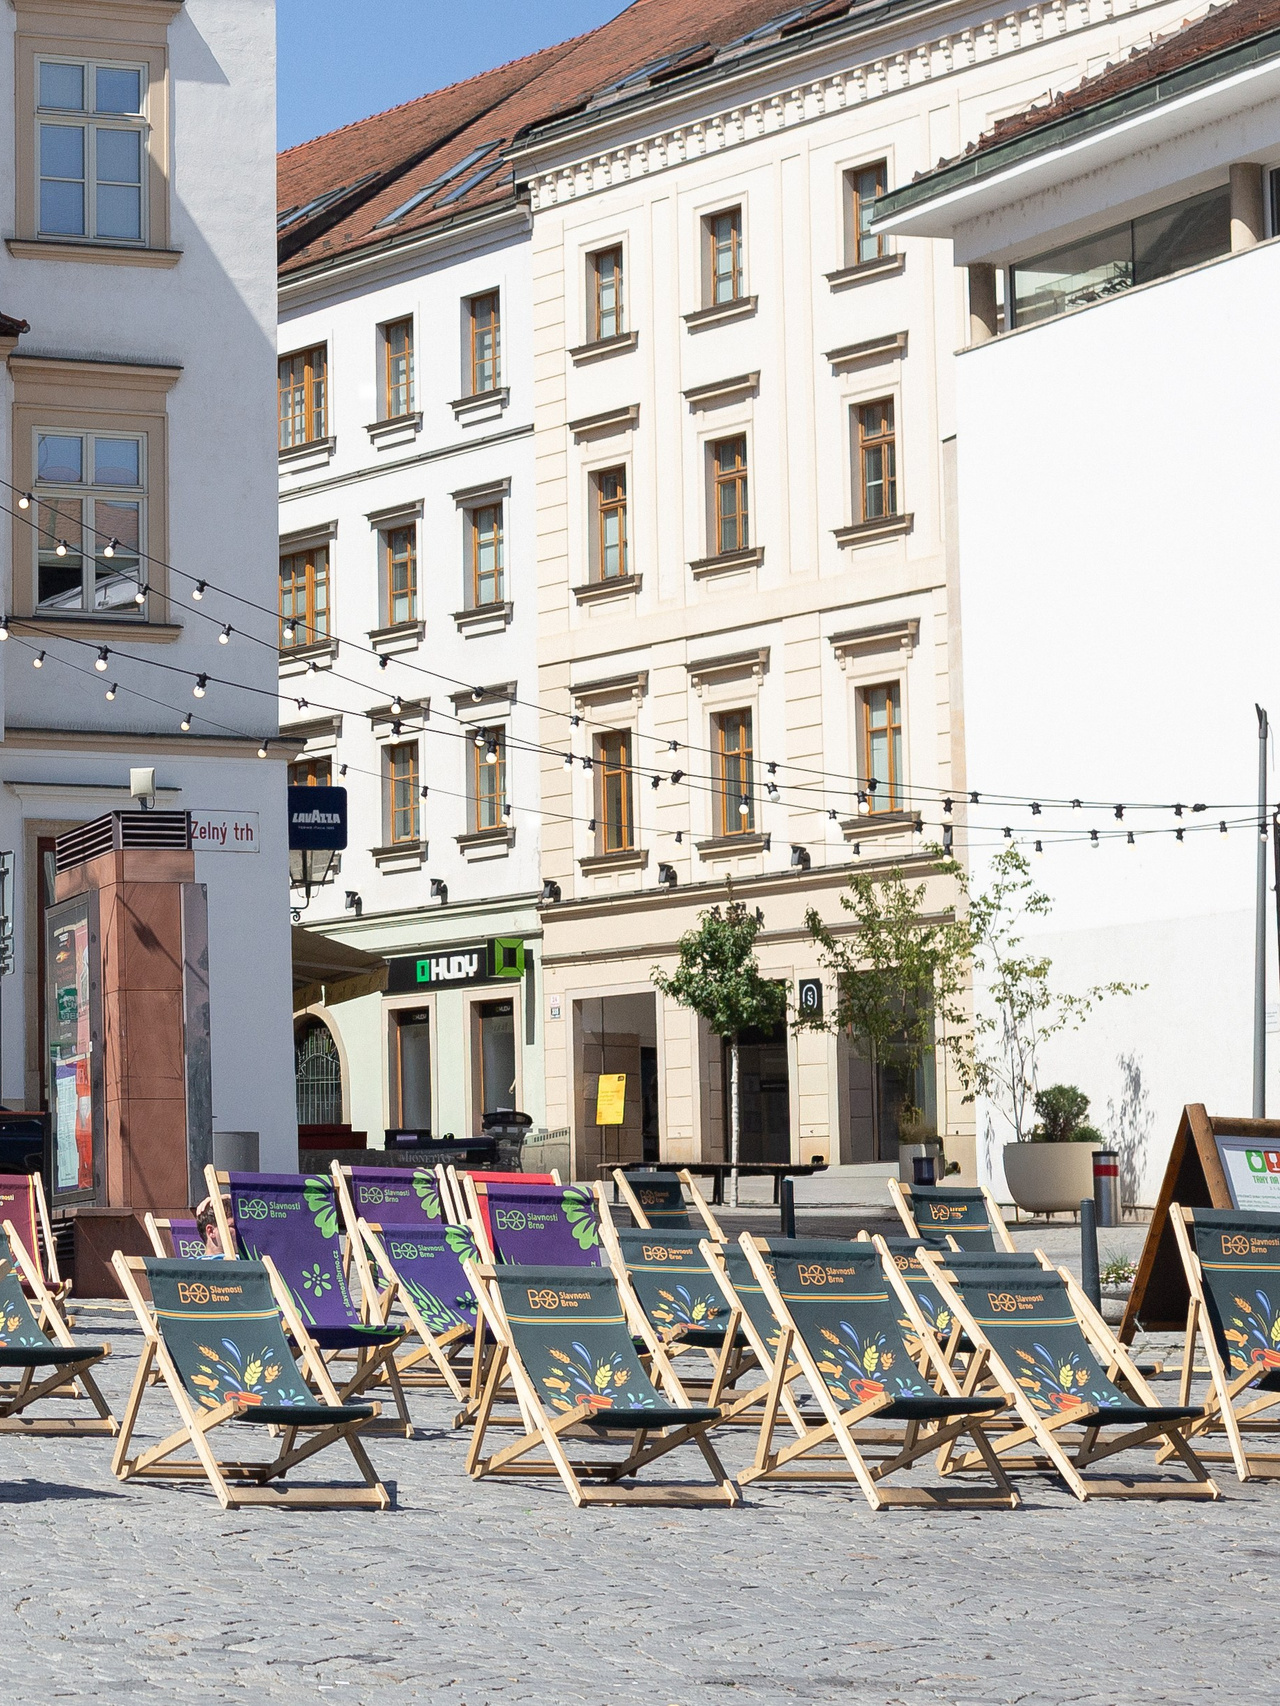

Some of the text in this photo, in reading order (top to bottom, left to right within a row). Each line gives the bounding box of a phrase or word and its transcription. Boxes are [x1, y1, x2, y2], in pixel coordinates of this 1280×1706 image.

[292, 809, 340, 824] LAVAZZA
[191, 820, 254, 845] Zelný trh
[431, 953, 478, 981] HUDY
[384, 1189, 410, 1197] Slavnosti
[269, 1201, 301, 1211] Slavnosti
[270, 1210, 287, 1219] Brno
[527, 1212, 558, 1222] Slavnosti
[528, 1221, 545, 1230] Brno
[1250, 1238, 1279, 1246] Slavnosti
[418, 1244, 445, 1252] Slavnosti
[1251, 1244, 1267, 1253] Brno
[826, 1267, 856, 1276] Slavnosti
[828, 1275, 844, 1283] Brno
[210, 1285, 243, 1294] Slavnosti
[211, 1293, 230, 1302] Brno
[559, 1291, 591, 1300] Slavnosti
[1015, 1295, 1045, 1303] Slavnosti
[560, 1299, 578, 1307] Brno
